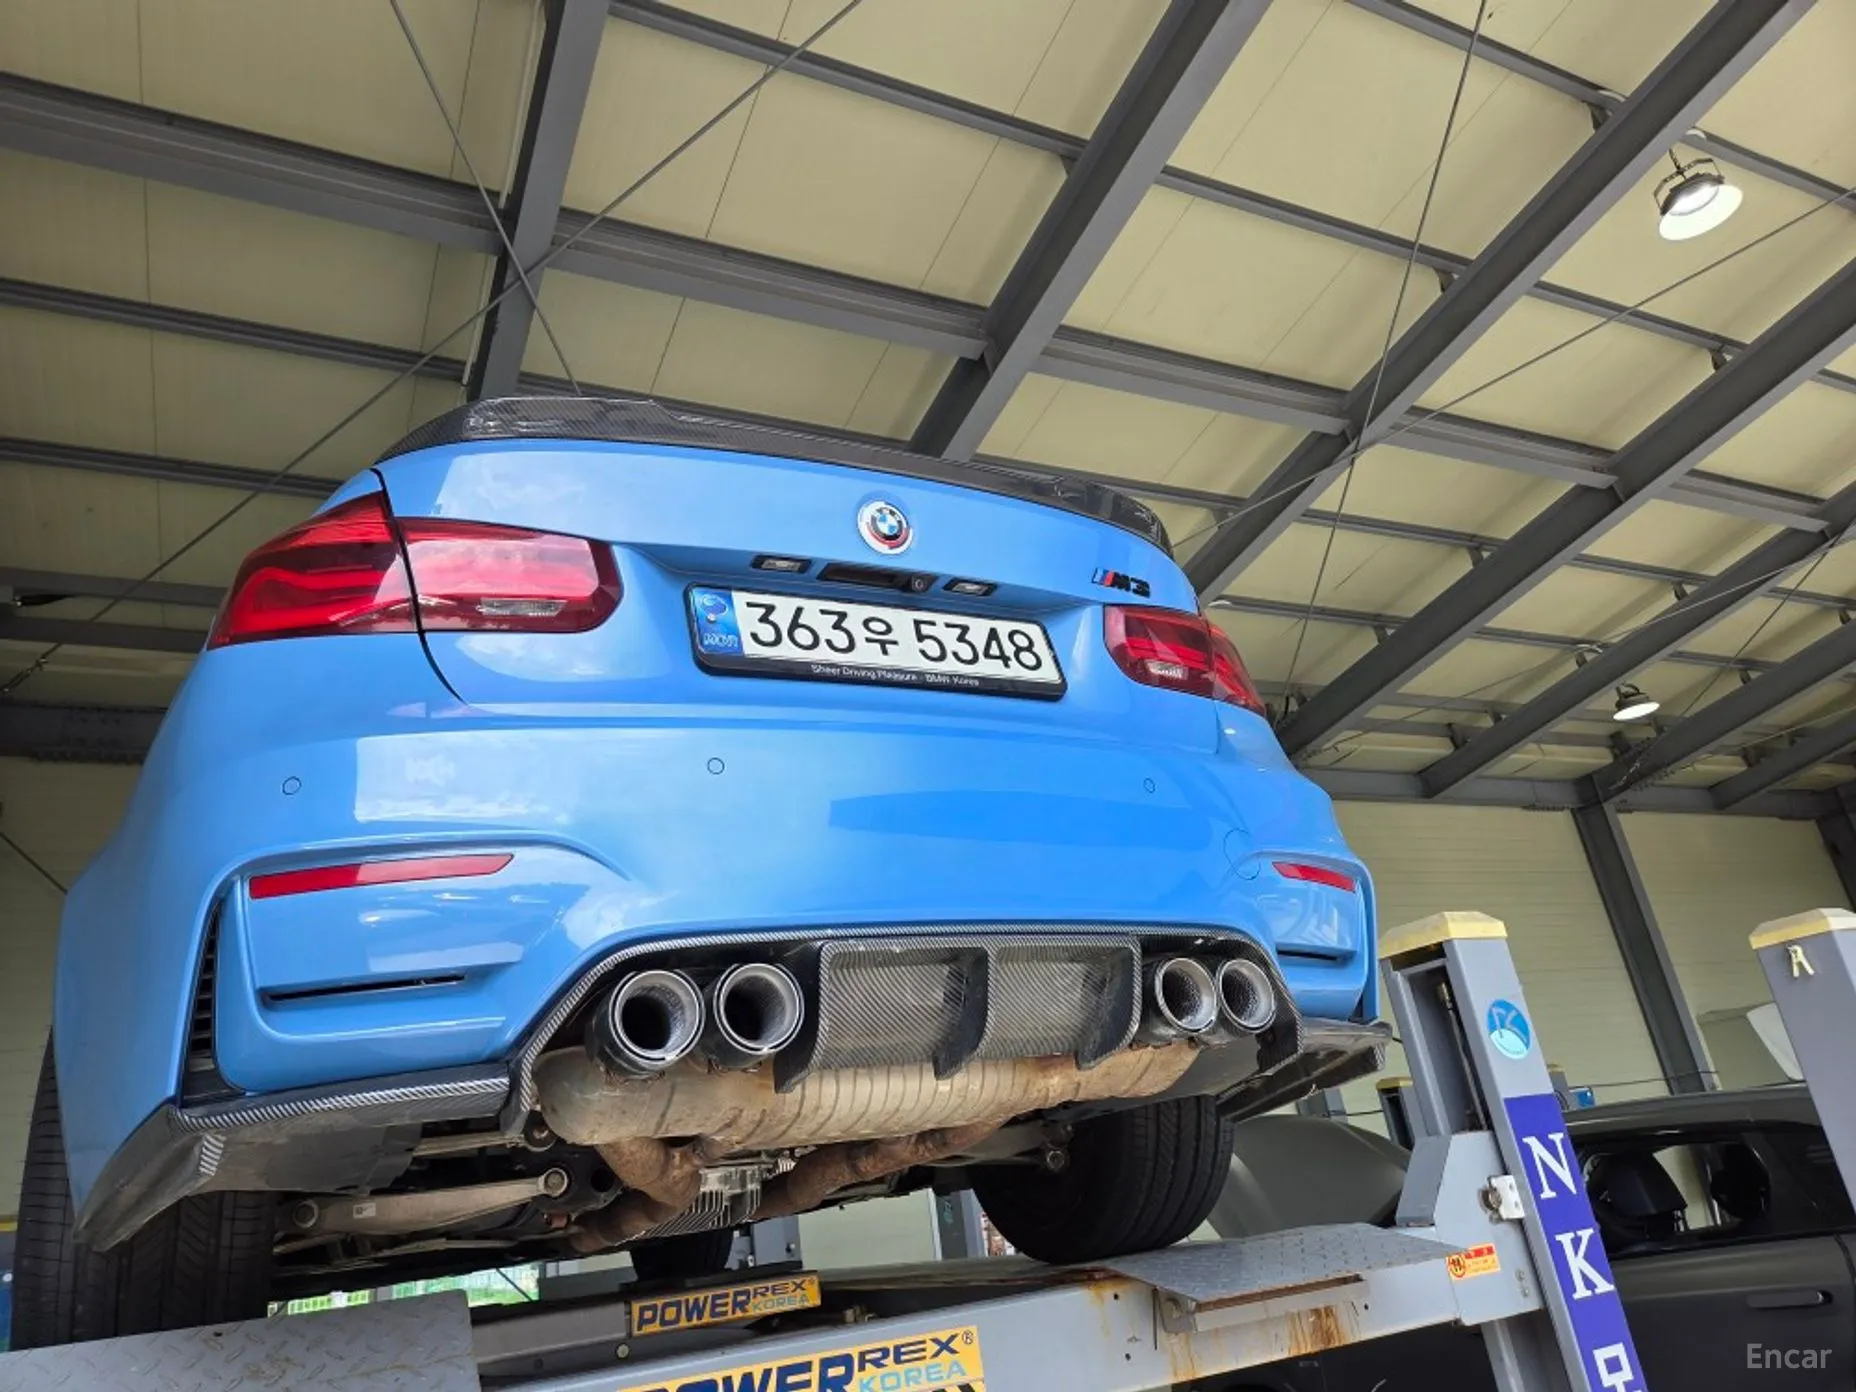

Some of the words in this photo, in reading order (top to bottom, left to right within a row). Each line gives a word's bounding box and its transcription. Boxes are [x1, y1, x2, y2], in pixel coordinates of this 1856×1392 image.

[1100, 569, 1150, 598] M3
[745, 601, 899, 656] 363우
[912, 618, 1042, 671] 5348
[811, 664, 840, 675] Sheer
[842, 666, 876, 680] Driving
[751, 1296, 809, 1311] KOREA
[859, 1360, 967, 1392] KOREA
